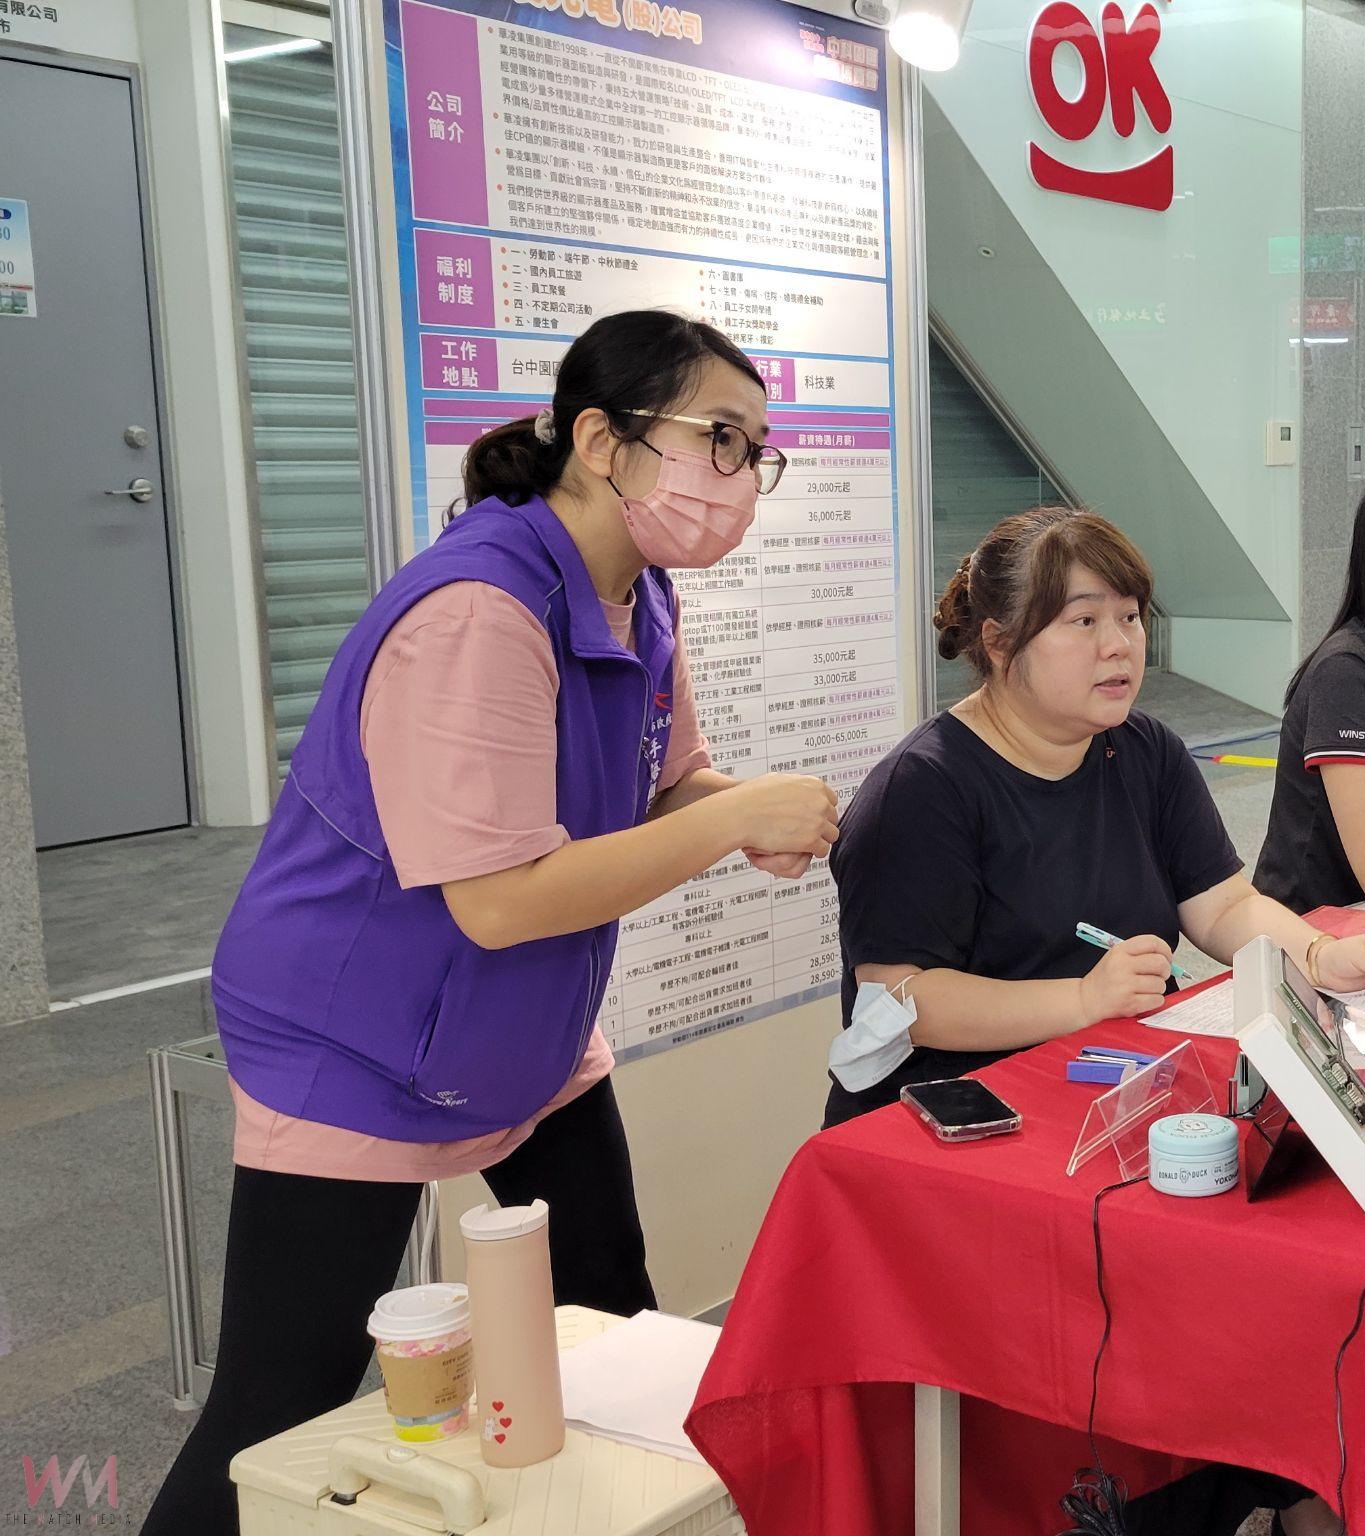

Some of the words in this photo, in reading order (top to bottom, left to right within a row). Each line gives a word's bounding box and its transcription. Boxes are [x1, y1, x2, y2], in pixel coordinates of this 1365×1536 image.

[1027, 2, 1173, 141] OK
[427, 90, 461, 116] 公司
[428, 117, 464, 144] 簡介
[437, 255, 472, 279] 福利
[438, 281, 474, 305] 制度
[441, 341, 477, 362] 工作
[442, 366, 479, 388] 地點
[755, 359, 783, 379] 行業
[804, 374, 836, 390] 科技業
[807, 481, 851, 494] 29,000元起
[808, 509, 852, 523] 36,000元起
[811, 585, 854, 599] 30,000元起
[813, 649, 857, 664] 35,000元起
[814, 670, 857, 686] 33,000元起
[804, 728, 868, 747] 40,000~65,000元
[608, 995, 618, 1007] 10
[611, 1020, 616, 1029] 1
[612, 1038, 616, 1048] 1
[1158, 1171, 1178, 1180] DONALD
[1191, 1168, 1208, 1179] DUCK
